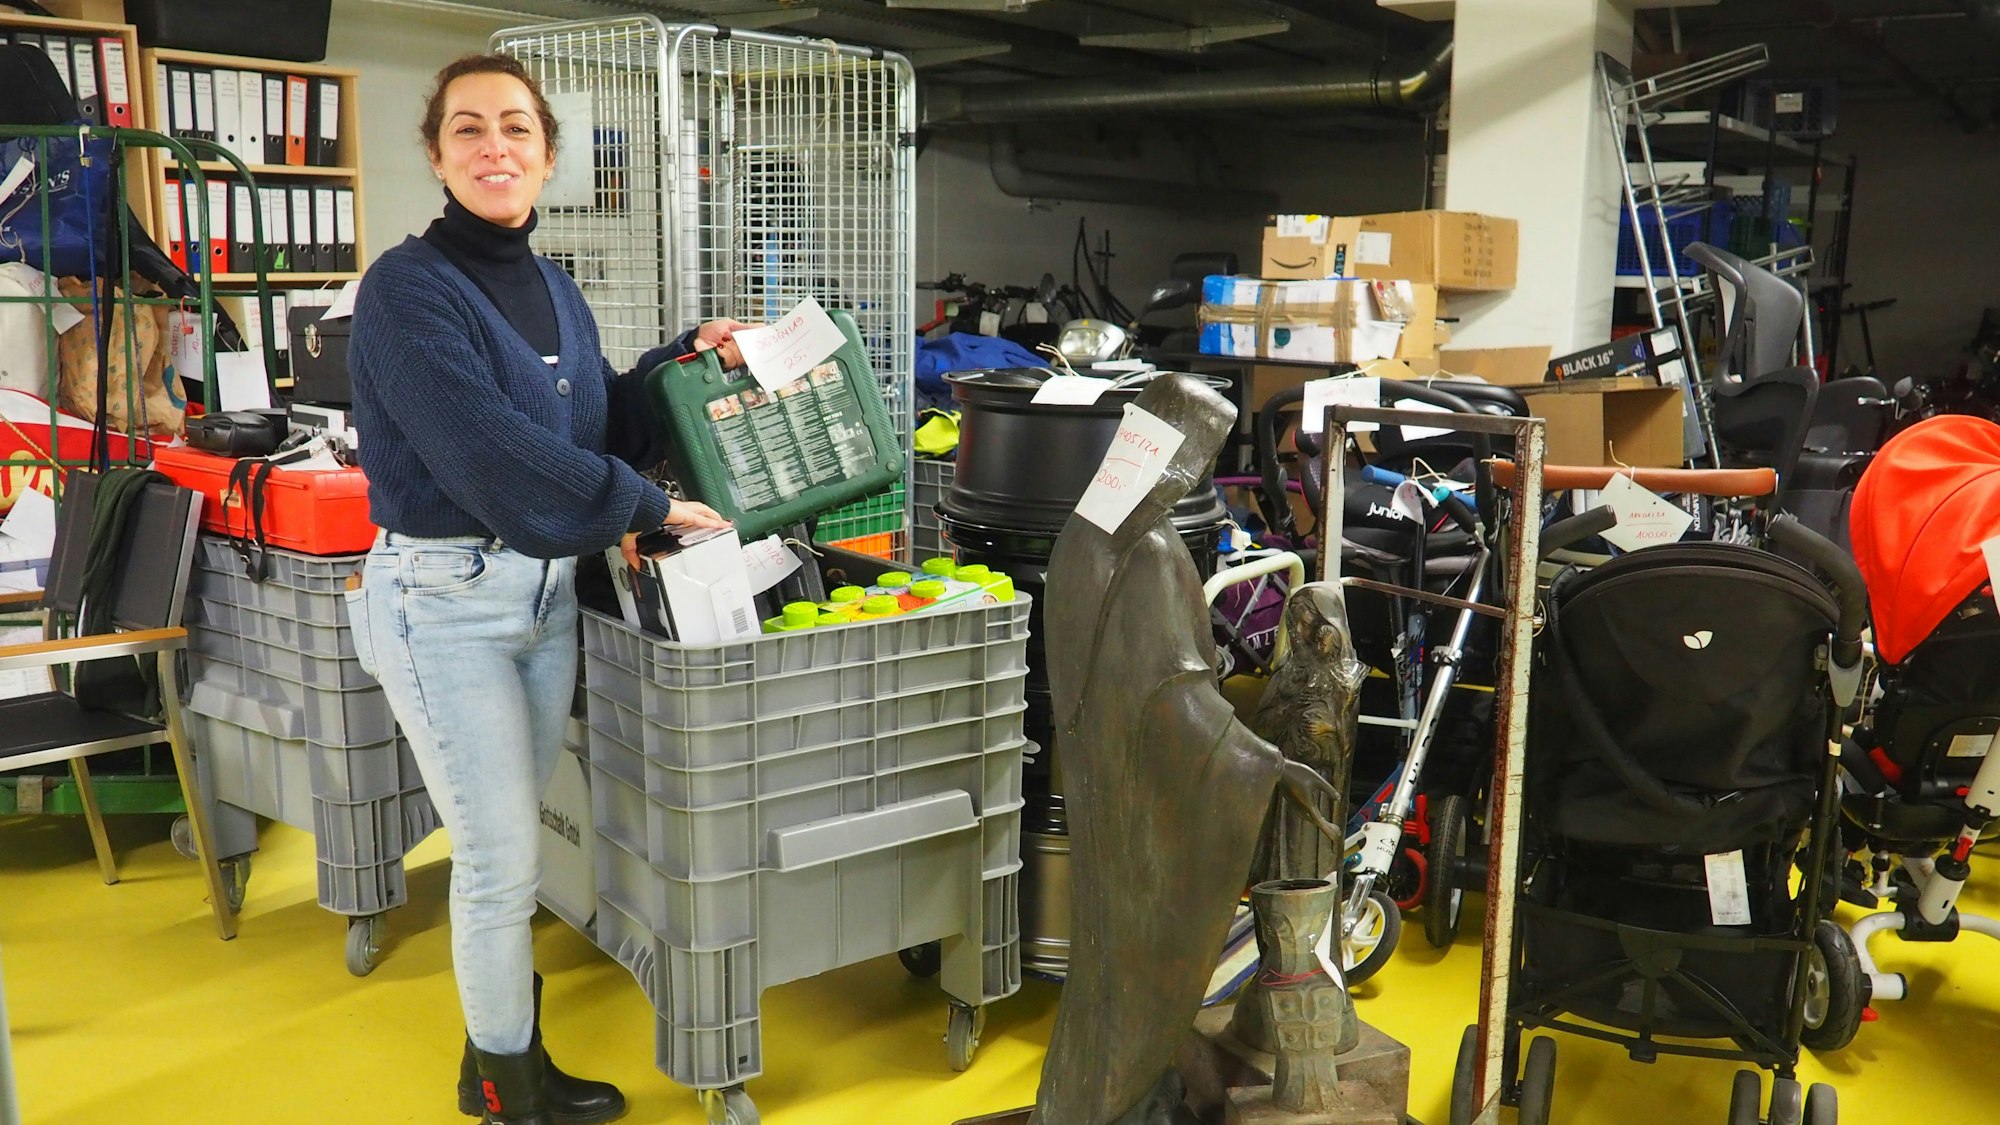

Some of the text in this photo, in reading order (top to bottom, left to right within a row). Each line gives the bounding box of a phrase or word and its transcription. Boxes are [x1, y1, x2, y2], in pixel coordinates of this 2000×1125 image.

[1562, 349, 1615, 377] BLACK 16"
[1692, 493, 1701, 532] EMINGTON
[565, 815, 581, 848] GmbH
[482, 1080, 502, 1113] 5
